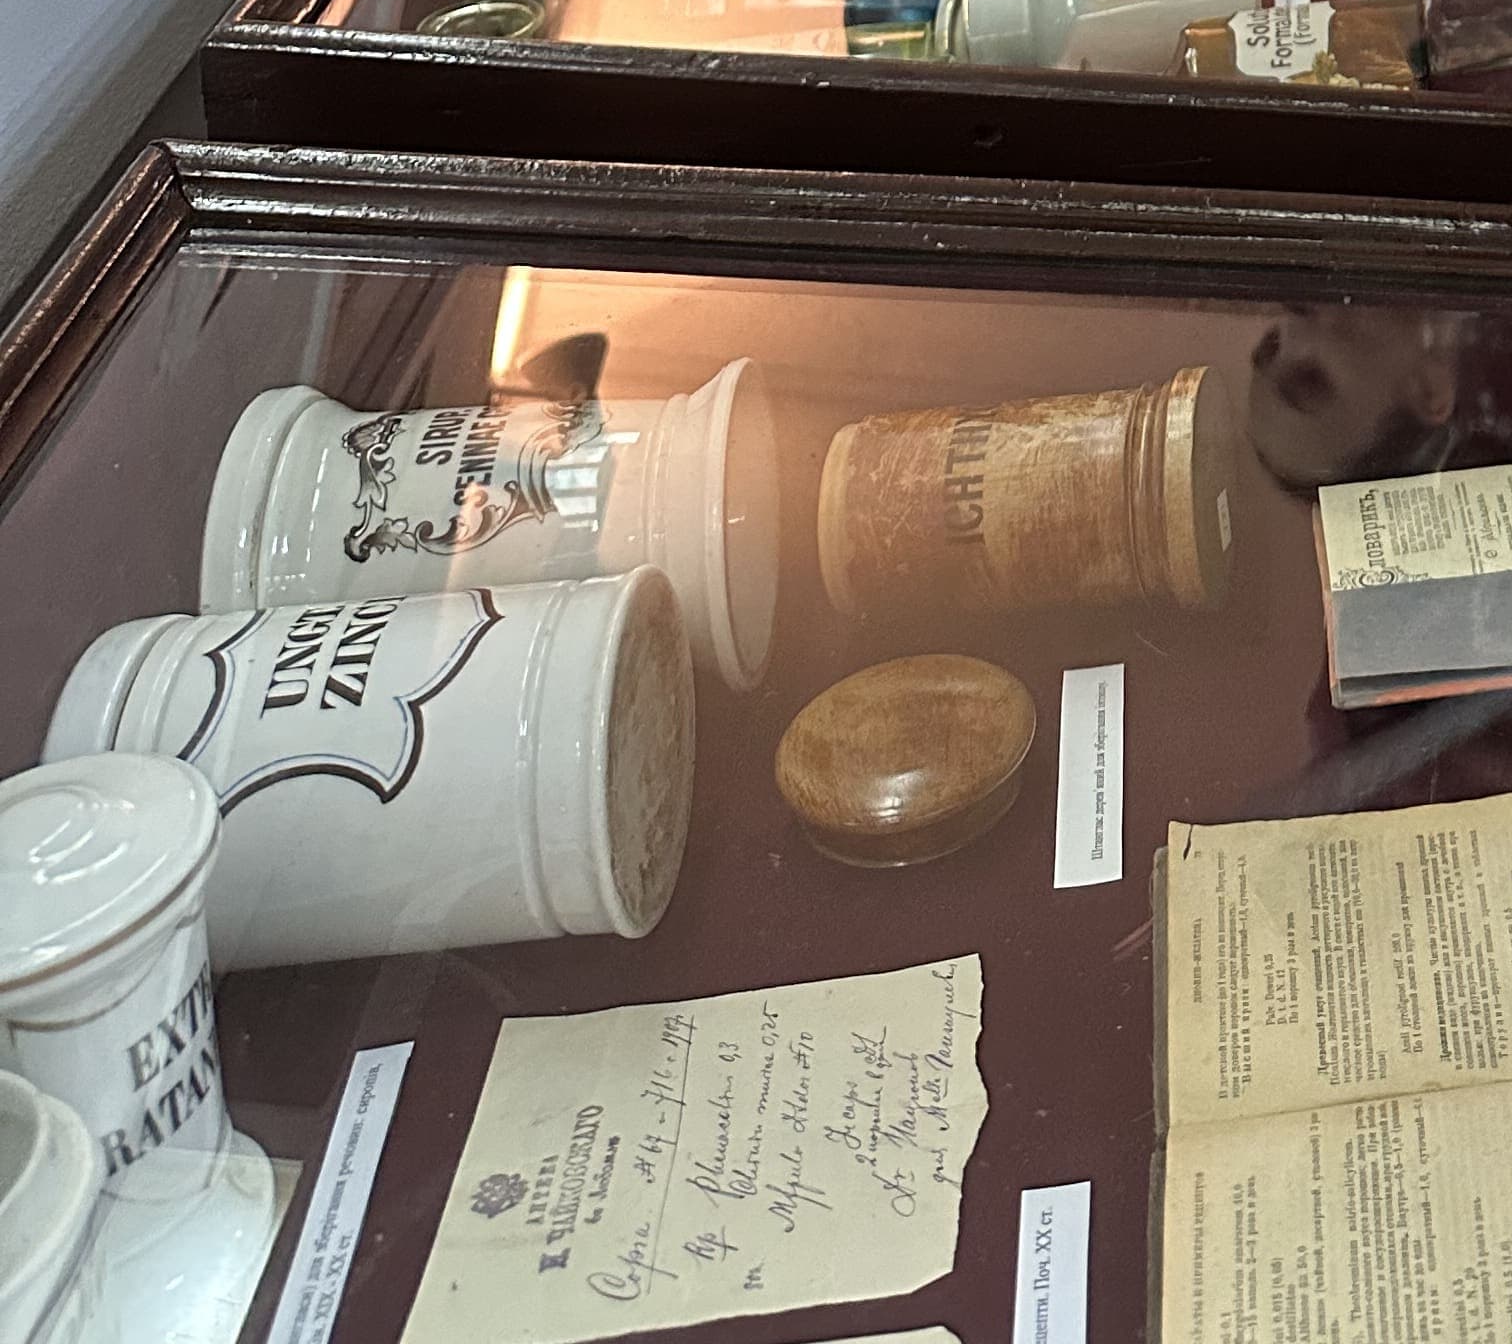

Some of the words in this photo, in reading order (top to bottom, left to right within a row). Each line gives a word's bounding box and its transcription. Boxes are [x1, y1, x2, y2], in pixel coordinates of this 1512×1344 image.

[1356, 489, 1393, 586] Словарикъ,
[1040, 1205, 1053, 1225] ст.
[1035, 1228, 1052, 1253] XX
[1033, 1256, 1050, 1290] Поч.
